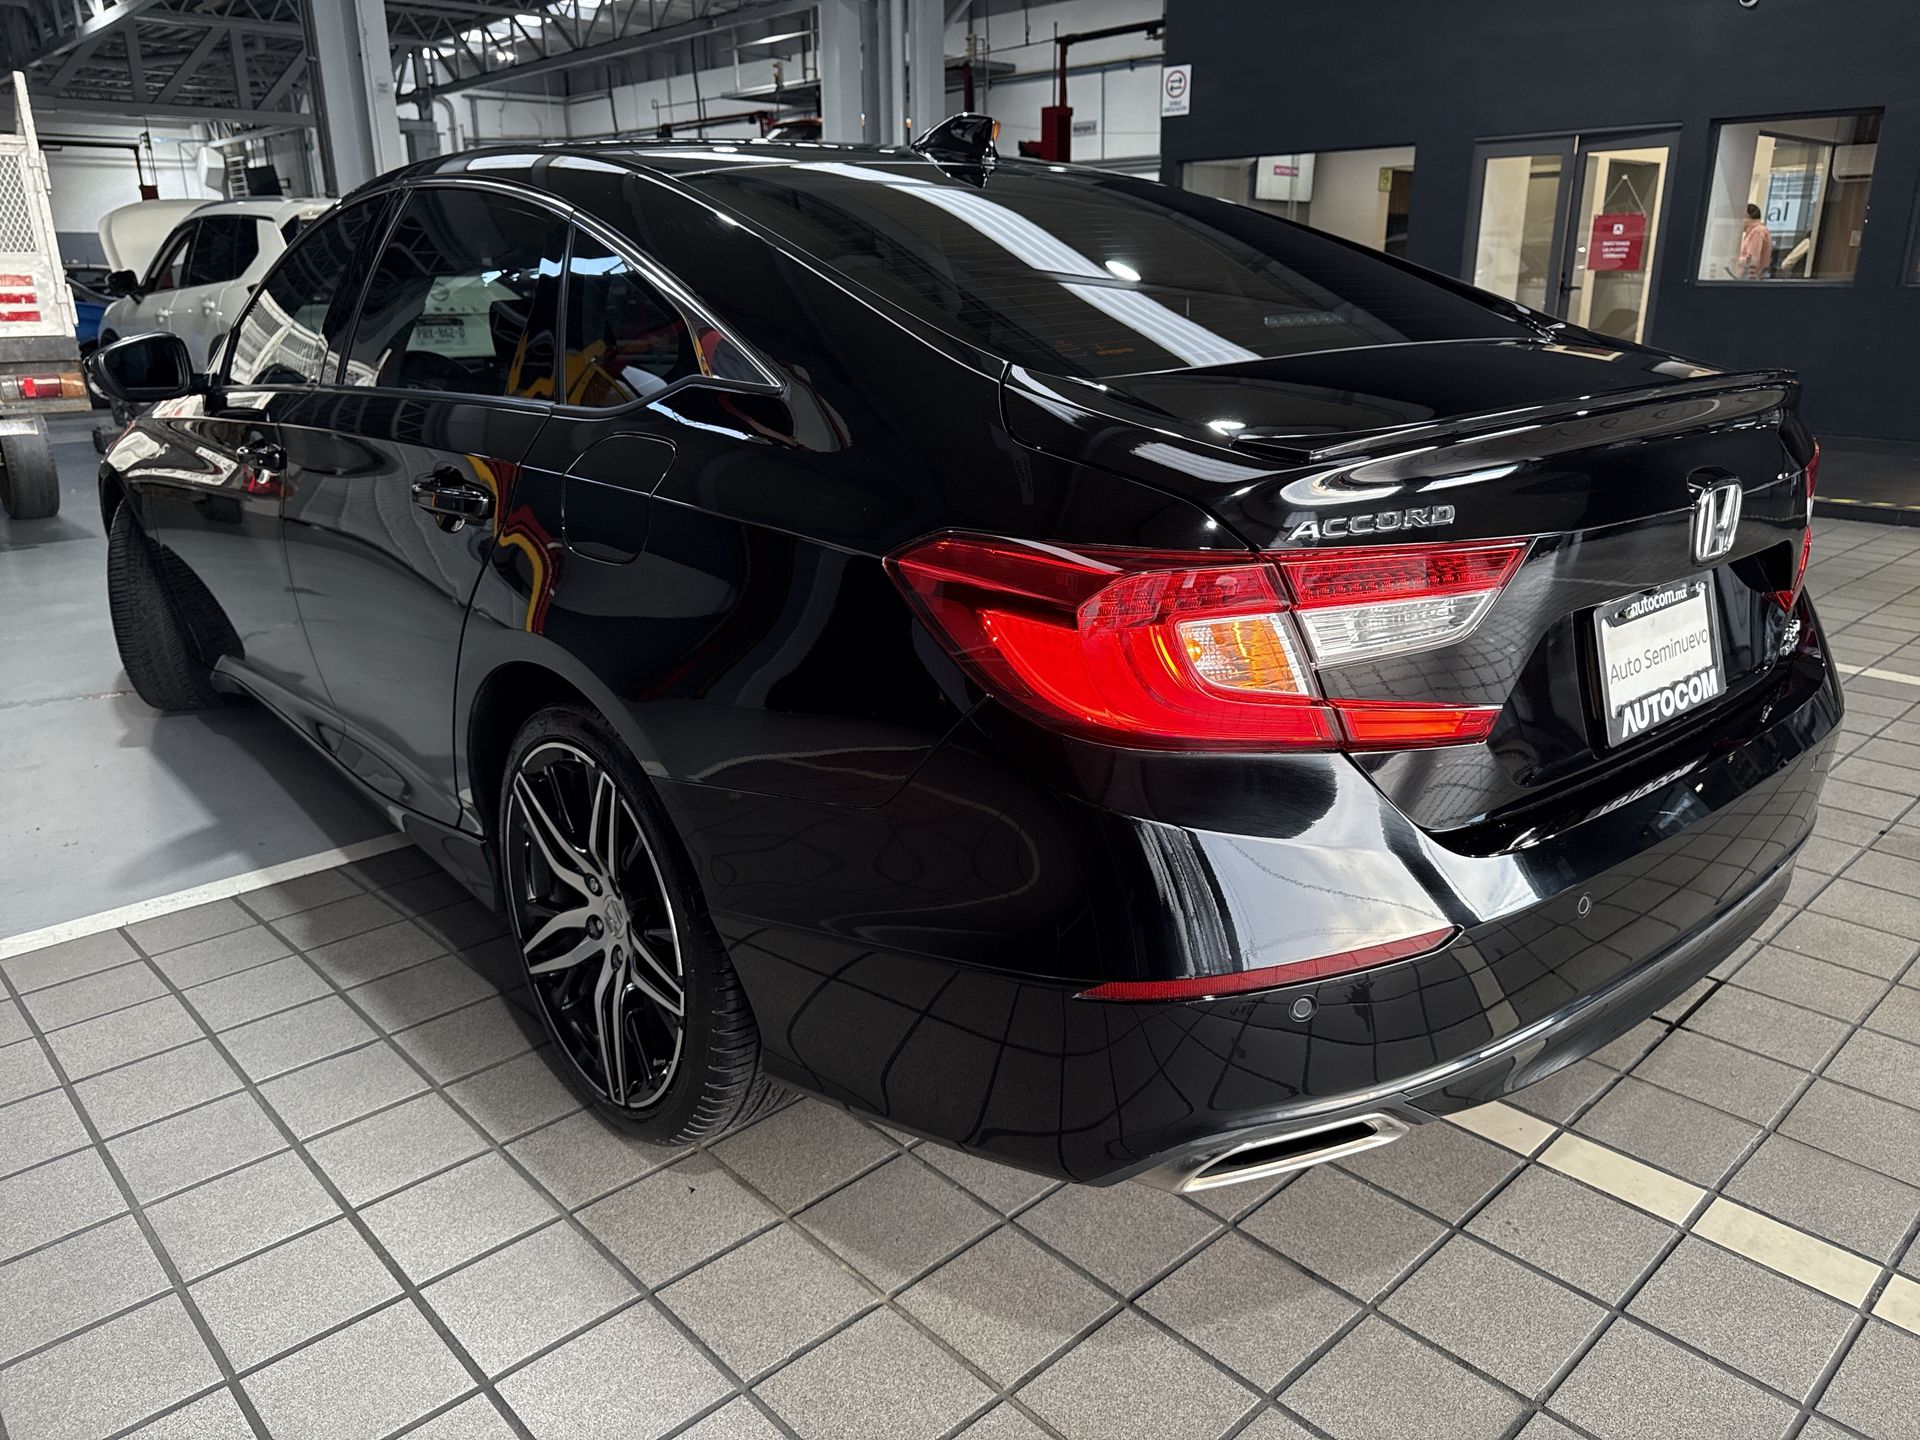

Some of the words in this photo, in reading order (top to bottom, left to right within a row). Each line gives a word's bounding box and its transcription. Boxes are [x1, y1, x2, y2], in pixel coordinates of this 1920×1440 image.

[1287, 504, 1456, 541] ACCORD
[1610, 657, 1642, 685] Auto
[1643, 628, 1709, 670] Seminuevo
[1622, 669, 1719, 738] AUTOCOM
